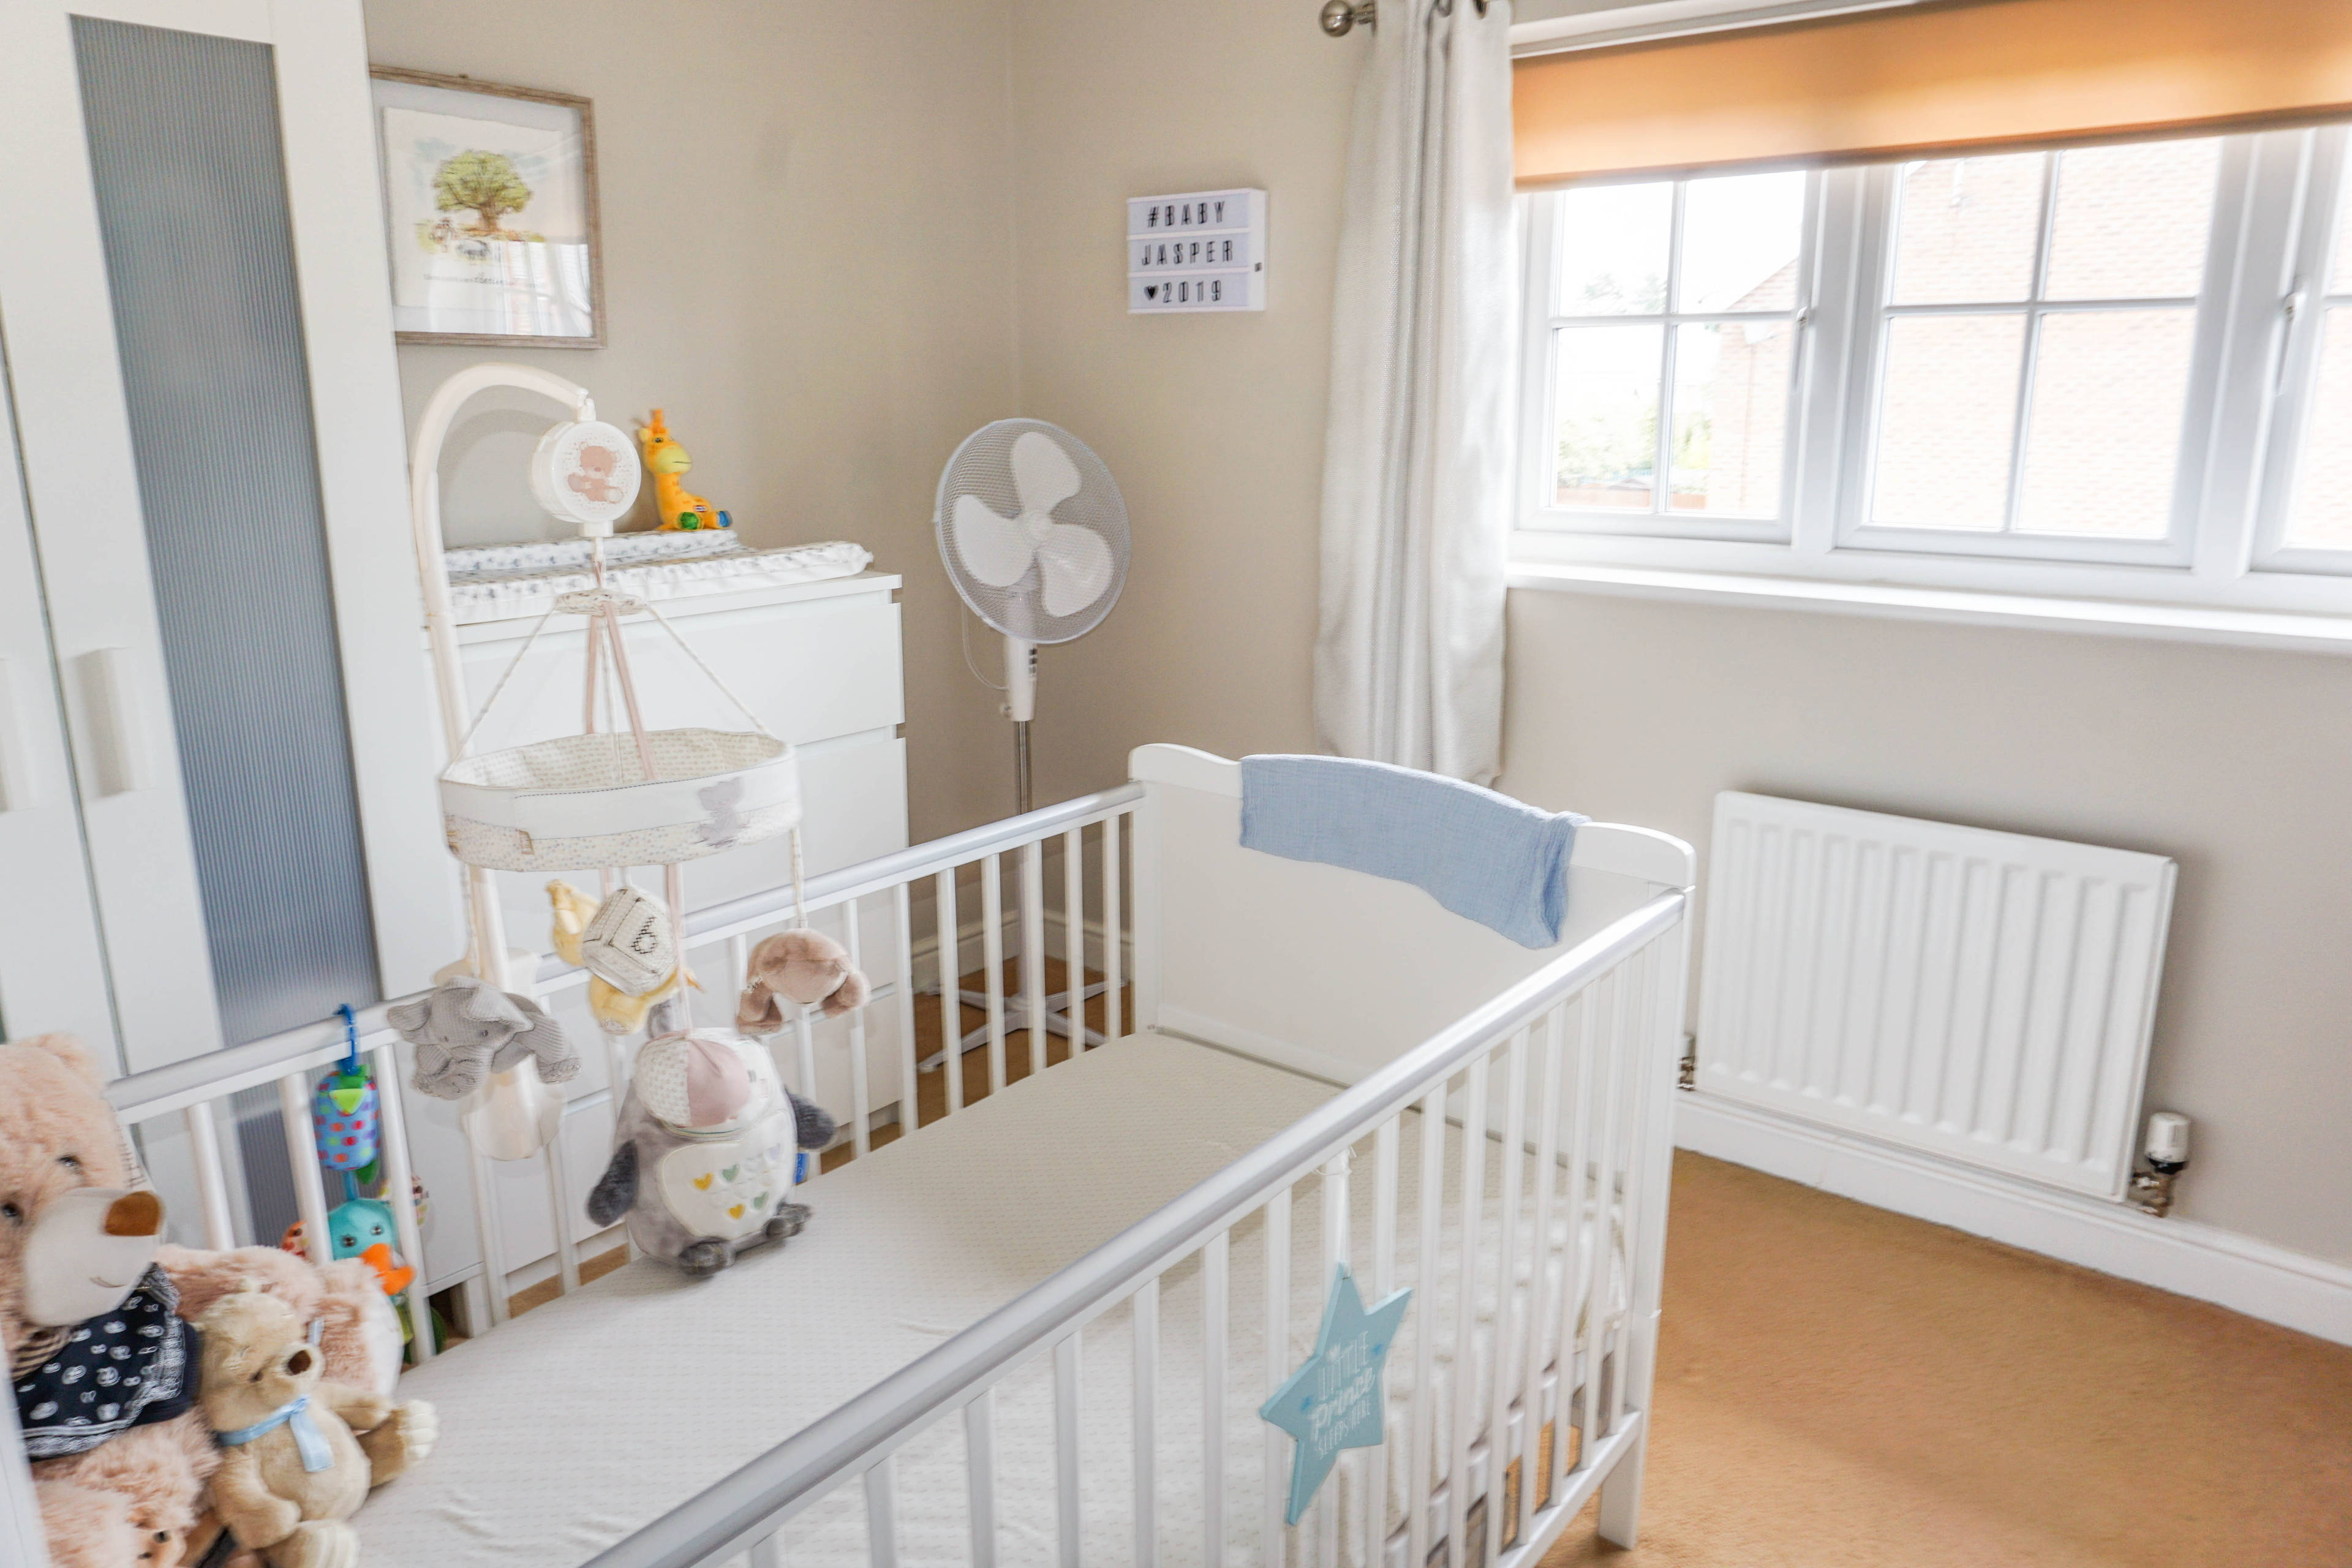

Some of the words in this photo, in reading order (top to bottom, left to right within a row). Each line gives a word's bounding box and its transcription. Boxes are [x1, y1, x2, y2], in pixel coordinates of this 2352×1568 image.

[1148, 200, 1225, 228] #BABY
[1142, 239, 1233, 265] JASPER
[1163, 279, 1222, 303] 2019
[1318, 1330, 1369, 1401] LITTLE
[1318, 1417, 1349, 1460] SLEEPS
[1351, 1396, 1371, 1430] HERE
